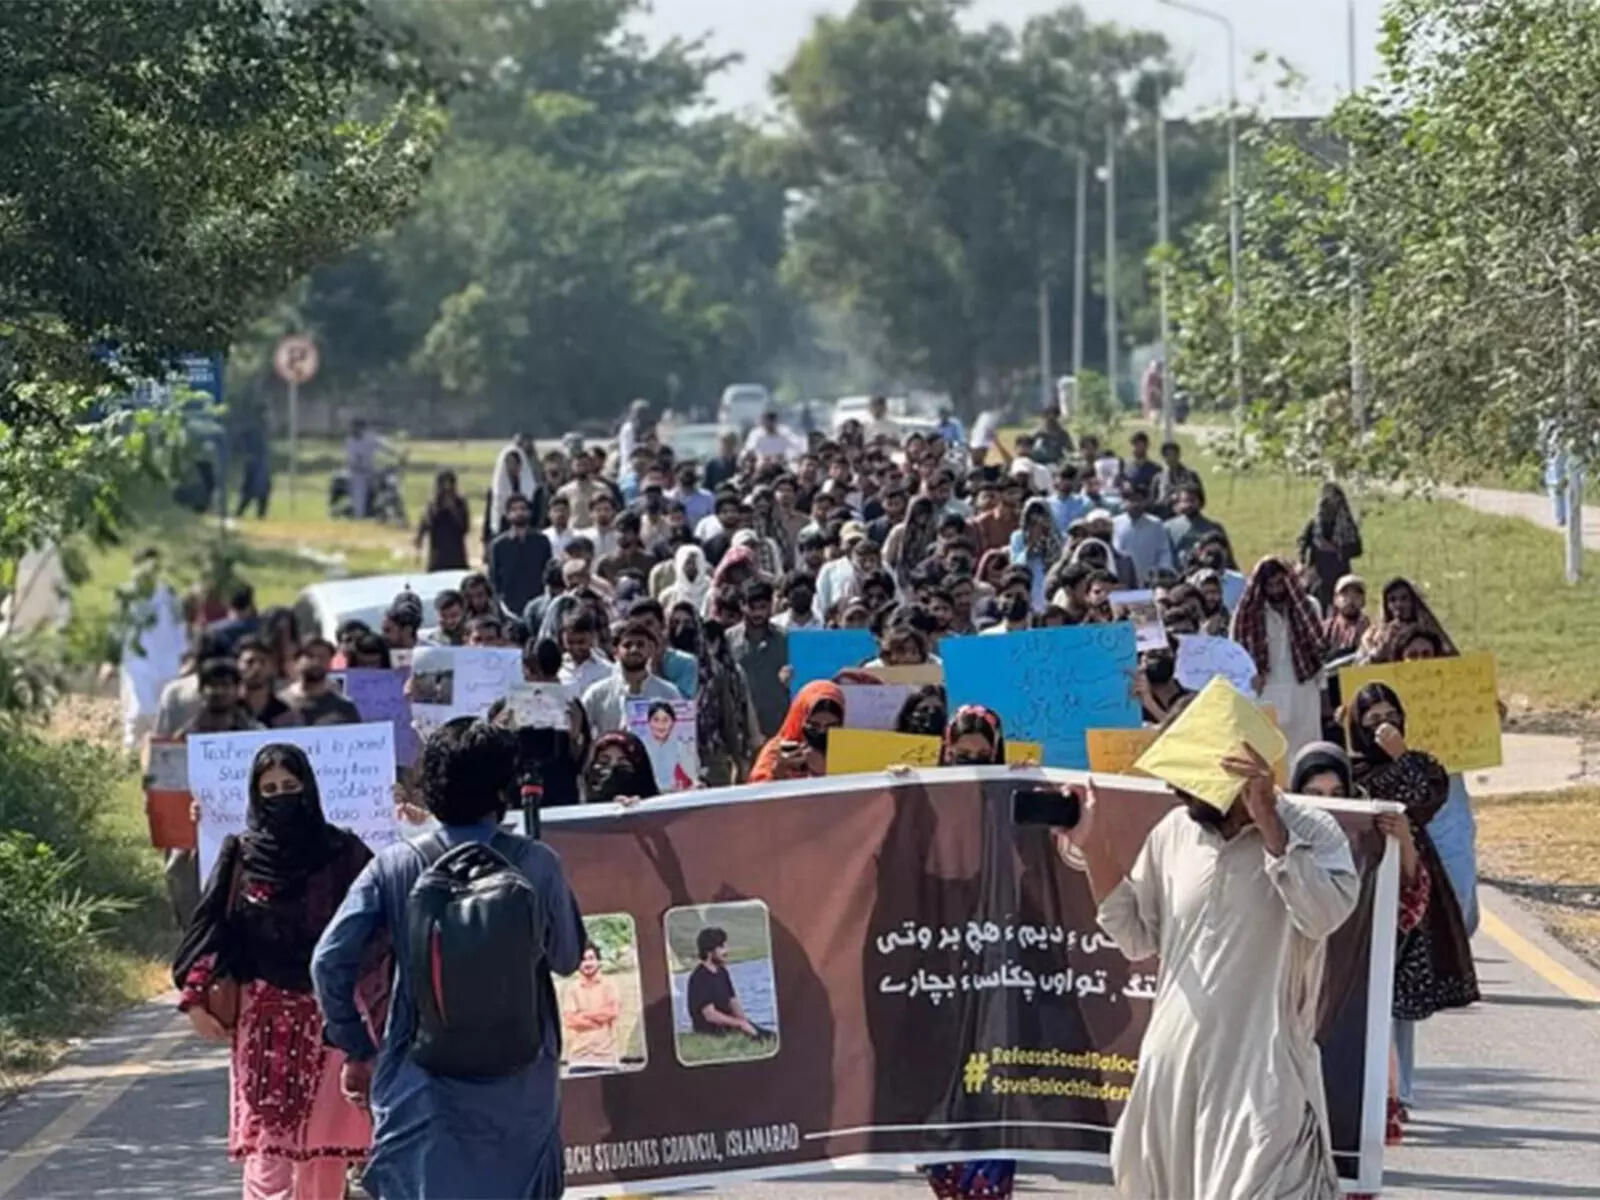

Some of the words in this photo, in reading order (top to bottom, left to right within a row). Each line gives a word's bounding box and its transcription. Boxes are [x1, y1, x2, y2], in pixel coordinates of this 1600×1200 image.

[991, 1076, 1131, 1101] SaveBalochStuden
[564, 1143, 593, 1175] OCH
[594, 1137, 659, 1172] STUDENTS
[661, 1131, 723, 1164] COUNCIL,
[726, 1121, 800, 1158] ISLAMABAD
